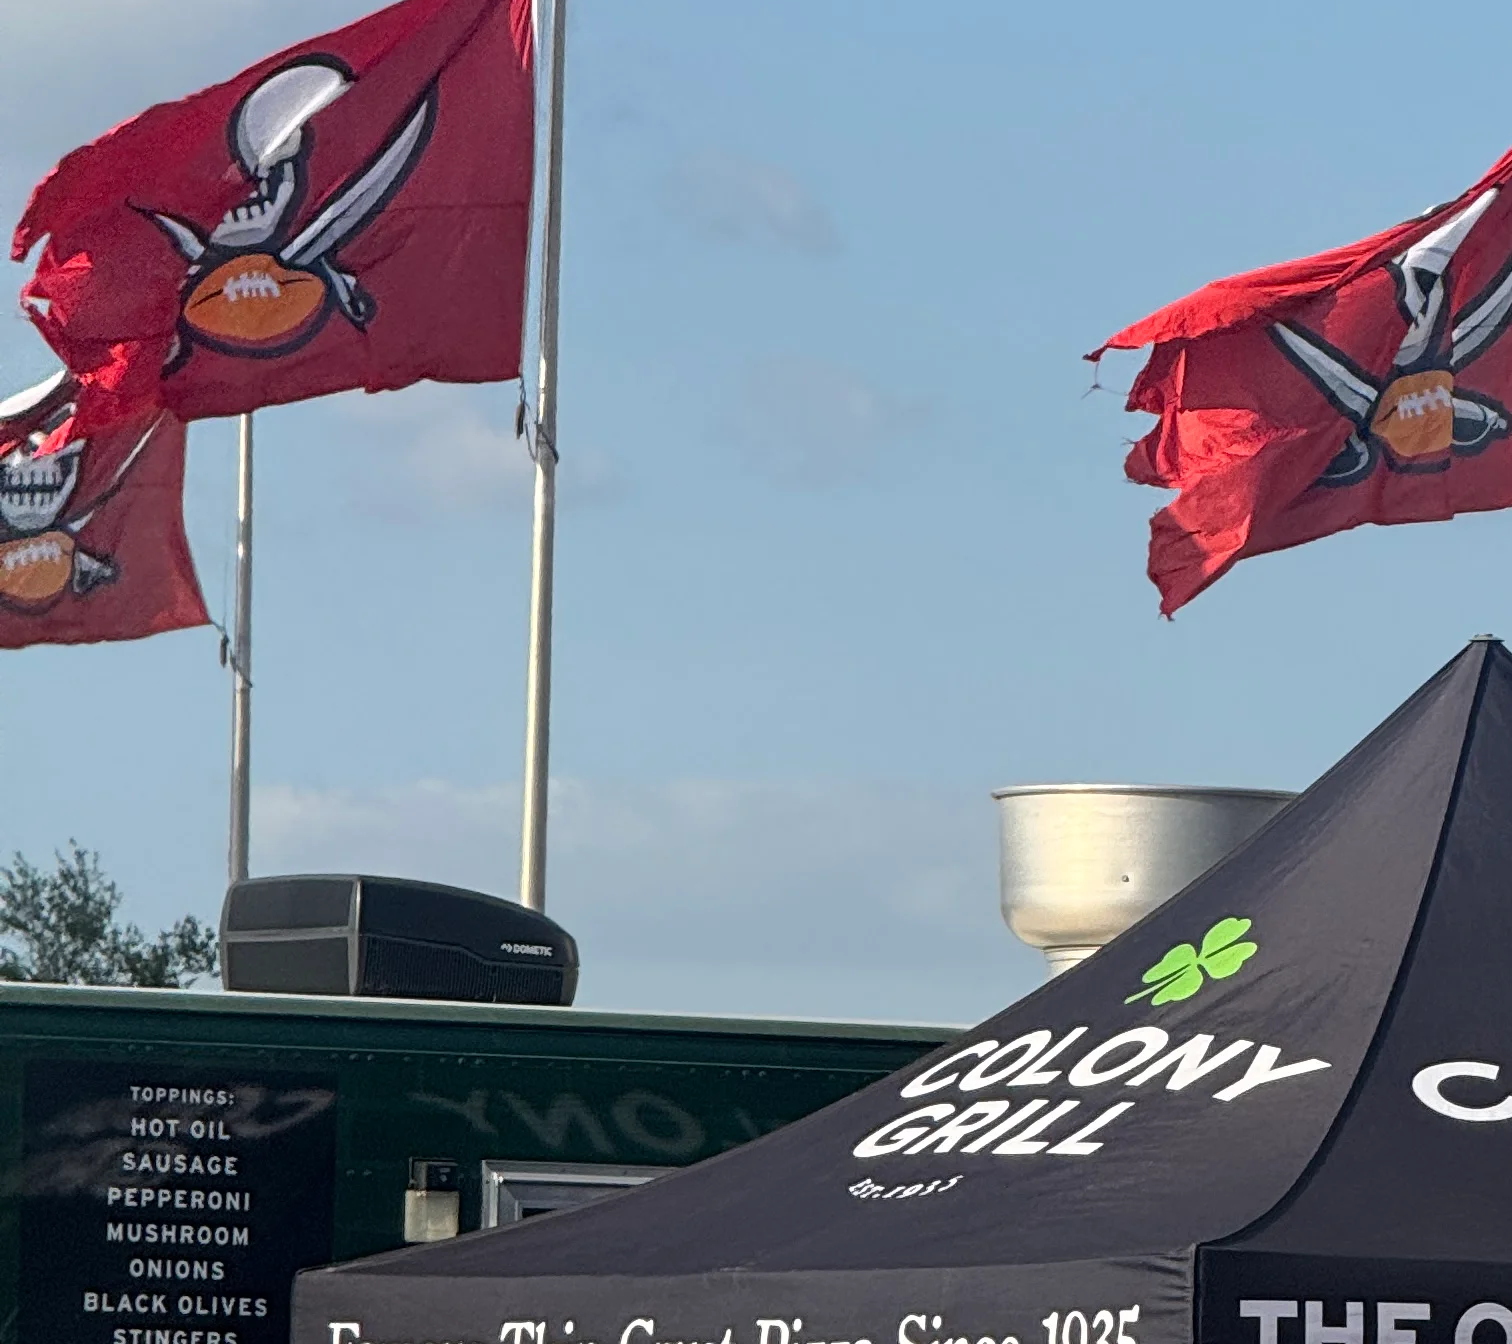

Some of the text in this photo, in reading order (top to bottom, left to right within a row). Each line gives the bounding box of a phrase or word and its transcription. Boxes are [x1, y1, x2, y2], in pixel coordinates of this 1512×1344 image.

[512, 943, 554, 958] DOMETIC
[899, 1026, 1332, 1101] COLONY
[130, 1086, 234, 1105] TOPPINGS:
[131, 1118, 230, 1140] HOT OIL
[853, 1094, 1135, 1157] GRILL
[122, 1152, 237, 1176] SAUSAGE
[107, 1187, 250, 1211] PEPPERONI
[107, 1223, 248, 1245] MUSHROOM
[129, 1259, 224, 1280] ONIONS
[84, 1292, 267, 1316] BLACK OLIVES
